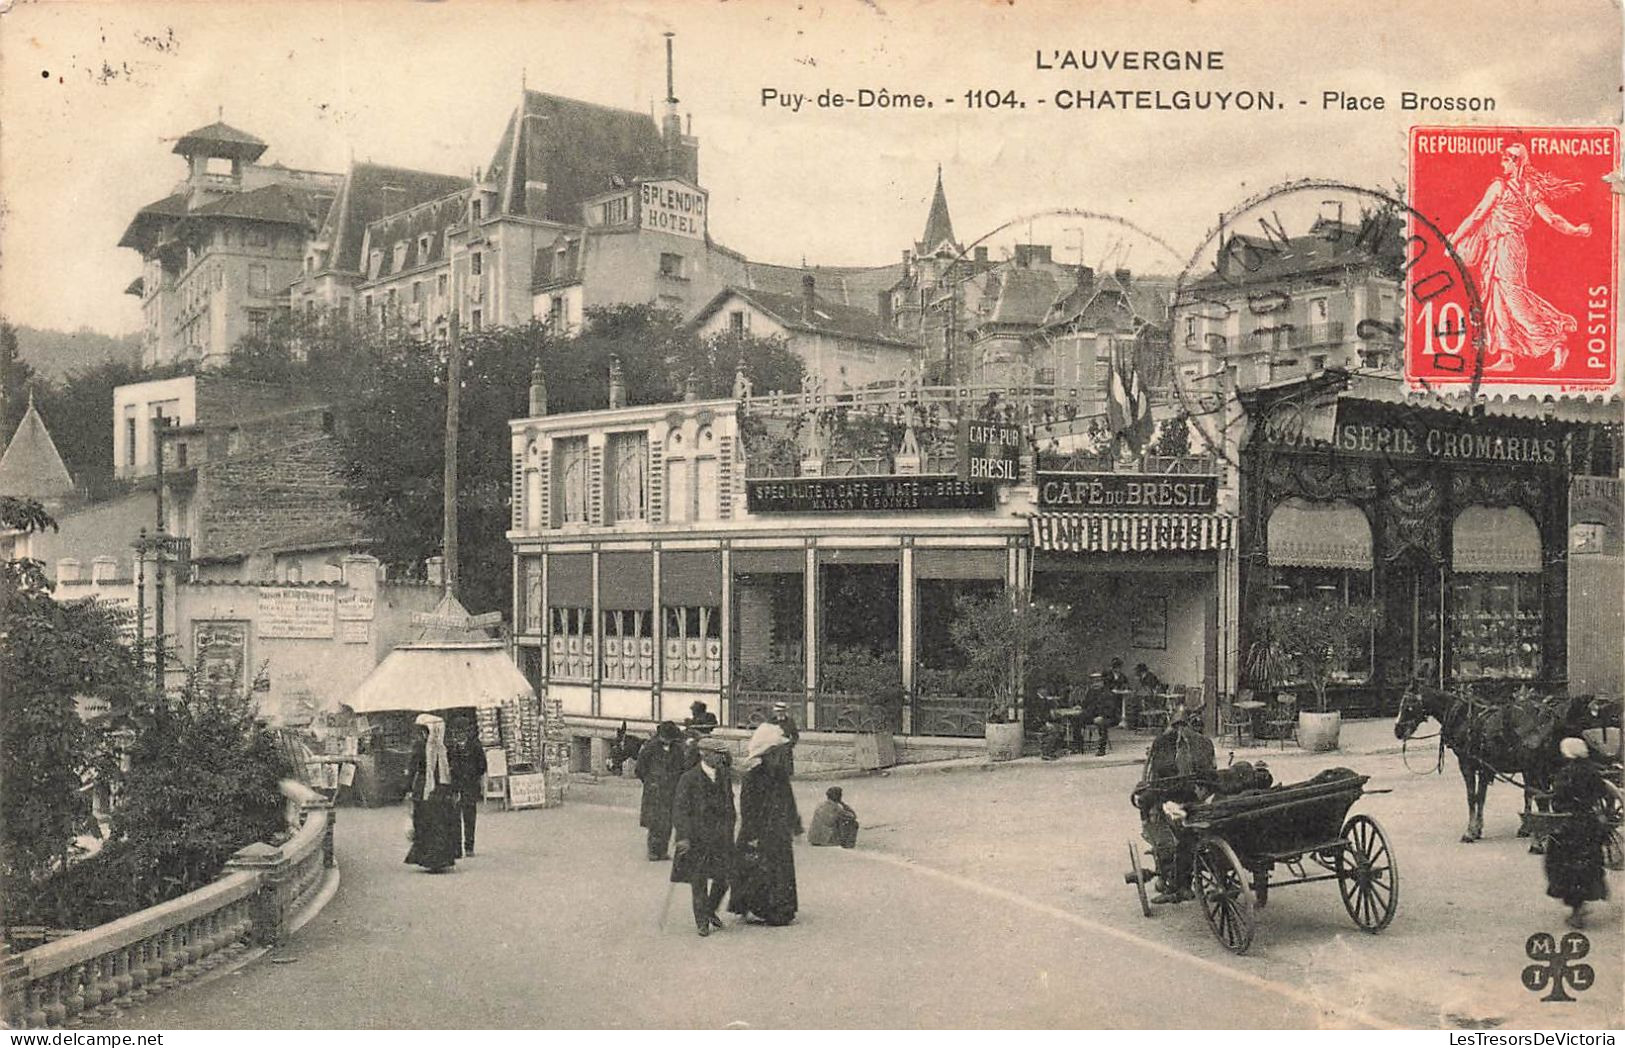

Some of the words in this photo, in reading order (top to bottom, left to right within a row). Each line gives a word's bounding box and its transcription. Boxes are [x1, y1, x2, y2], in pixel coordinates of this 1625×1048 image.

[1531, 137, 1611, 157] FRANÇAISE
[643, 184, 703, 216] SPLENDID
[649, 209, 697, 233] HOTEL
[1416, 300, 1466, 355] 10
[1588, 285, 1608, 369] POSTES
[970, 424, 996, 444] CAFÉ
[1000, 428, 1019, 446] PUR
[1427, 429, 1556, 462] CROMARIAS
[1043, 479, 1104, 505] CAFÉ
[1106, 491, 1123, 505] DU
[1126, 480, 1212, 506] BRÉSIL
